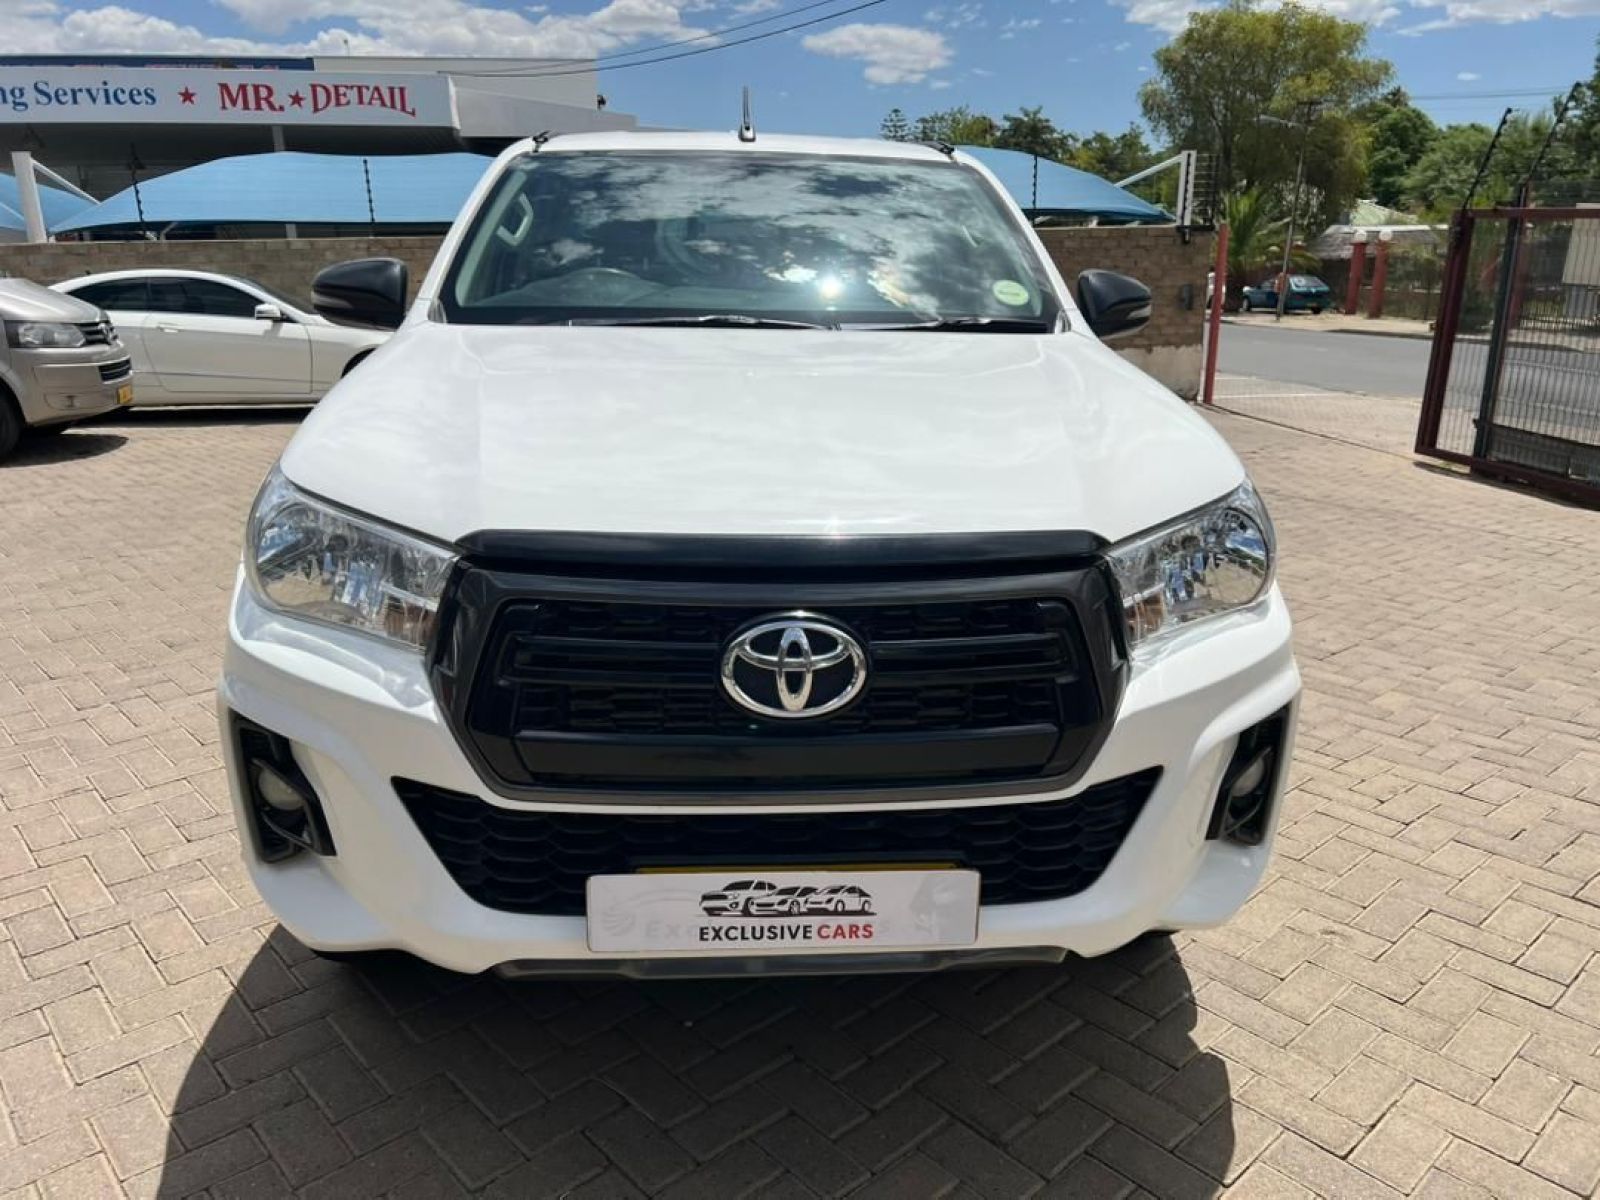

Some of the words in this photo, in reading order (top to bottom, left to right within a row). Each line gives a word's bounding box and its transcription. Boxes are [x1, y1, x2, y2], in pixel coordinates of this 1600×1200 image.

[33, 80, 157, 106] Services
[217, 82, 285, 112] MR.
[309, 83, 416, 117] DETAIL
[699, 925, 812, 942] EXCLUSIVE
[816, 924, 874, 940] CARS
